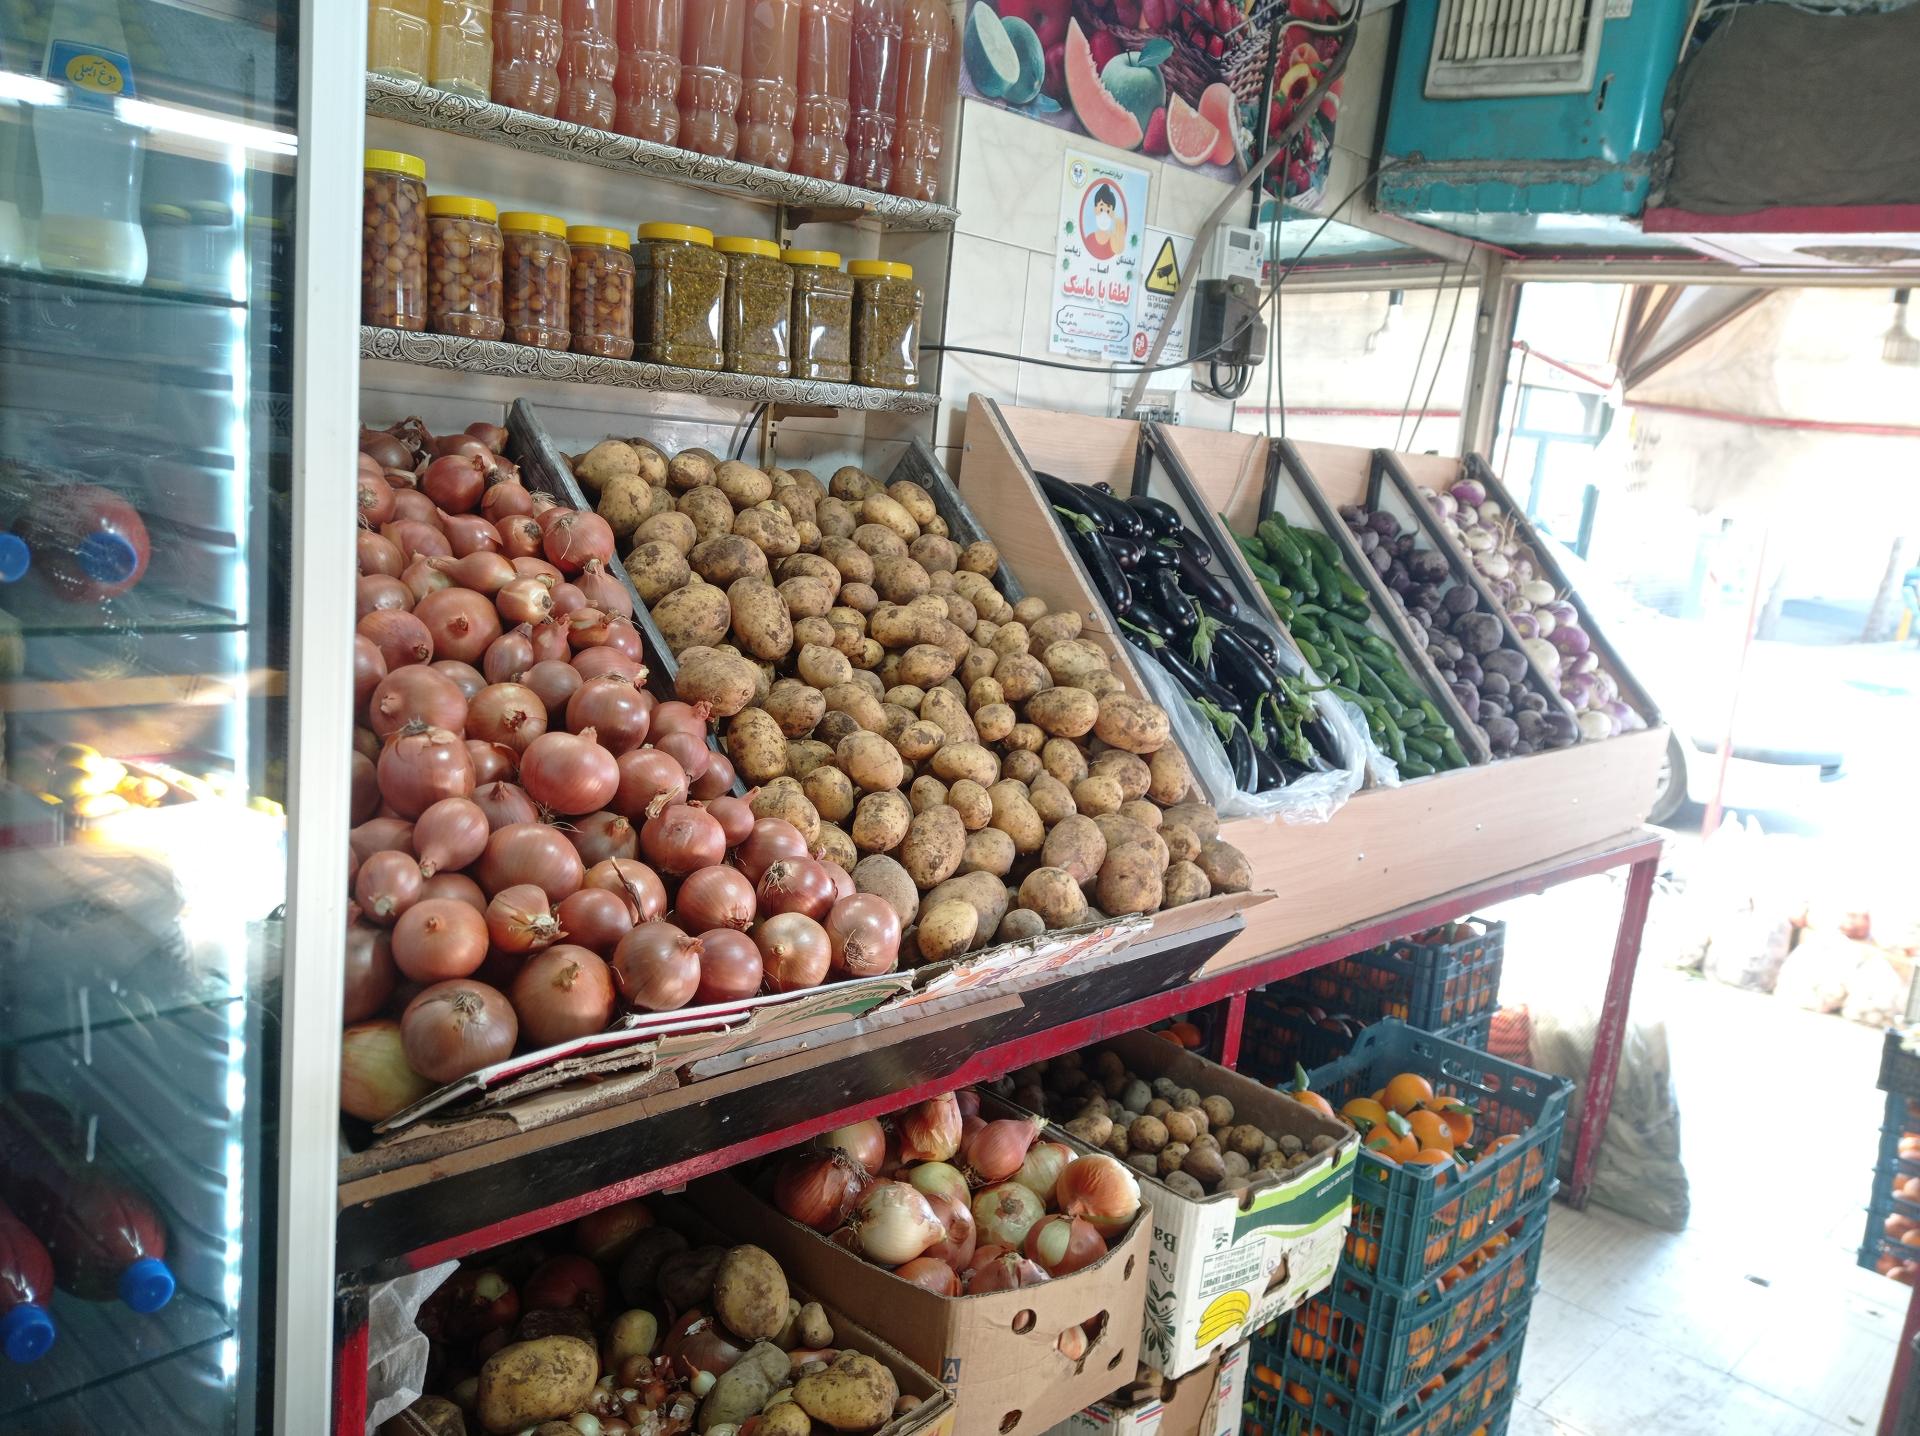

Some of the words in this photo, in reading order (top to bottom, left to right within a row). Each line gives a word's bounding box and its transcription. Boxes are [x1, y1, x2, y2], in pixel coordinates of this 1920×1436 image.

[1063, 274, 1095, 298] ماسک
[1098, 279, 1106, 305] با
[1109, 281, 1131, 304] لطفا
[1146, 294, 1158, 303] CCTV
[1154, 1226, 1178, 1254] Ba
